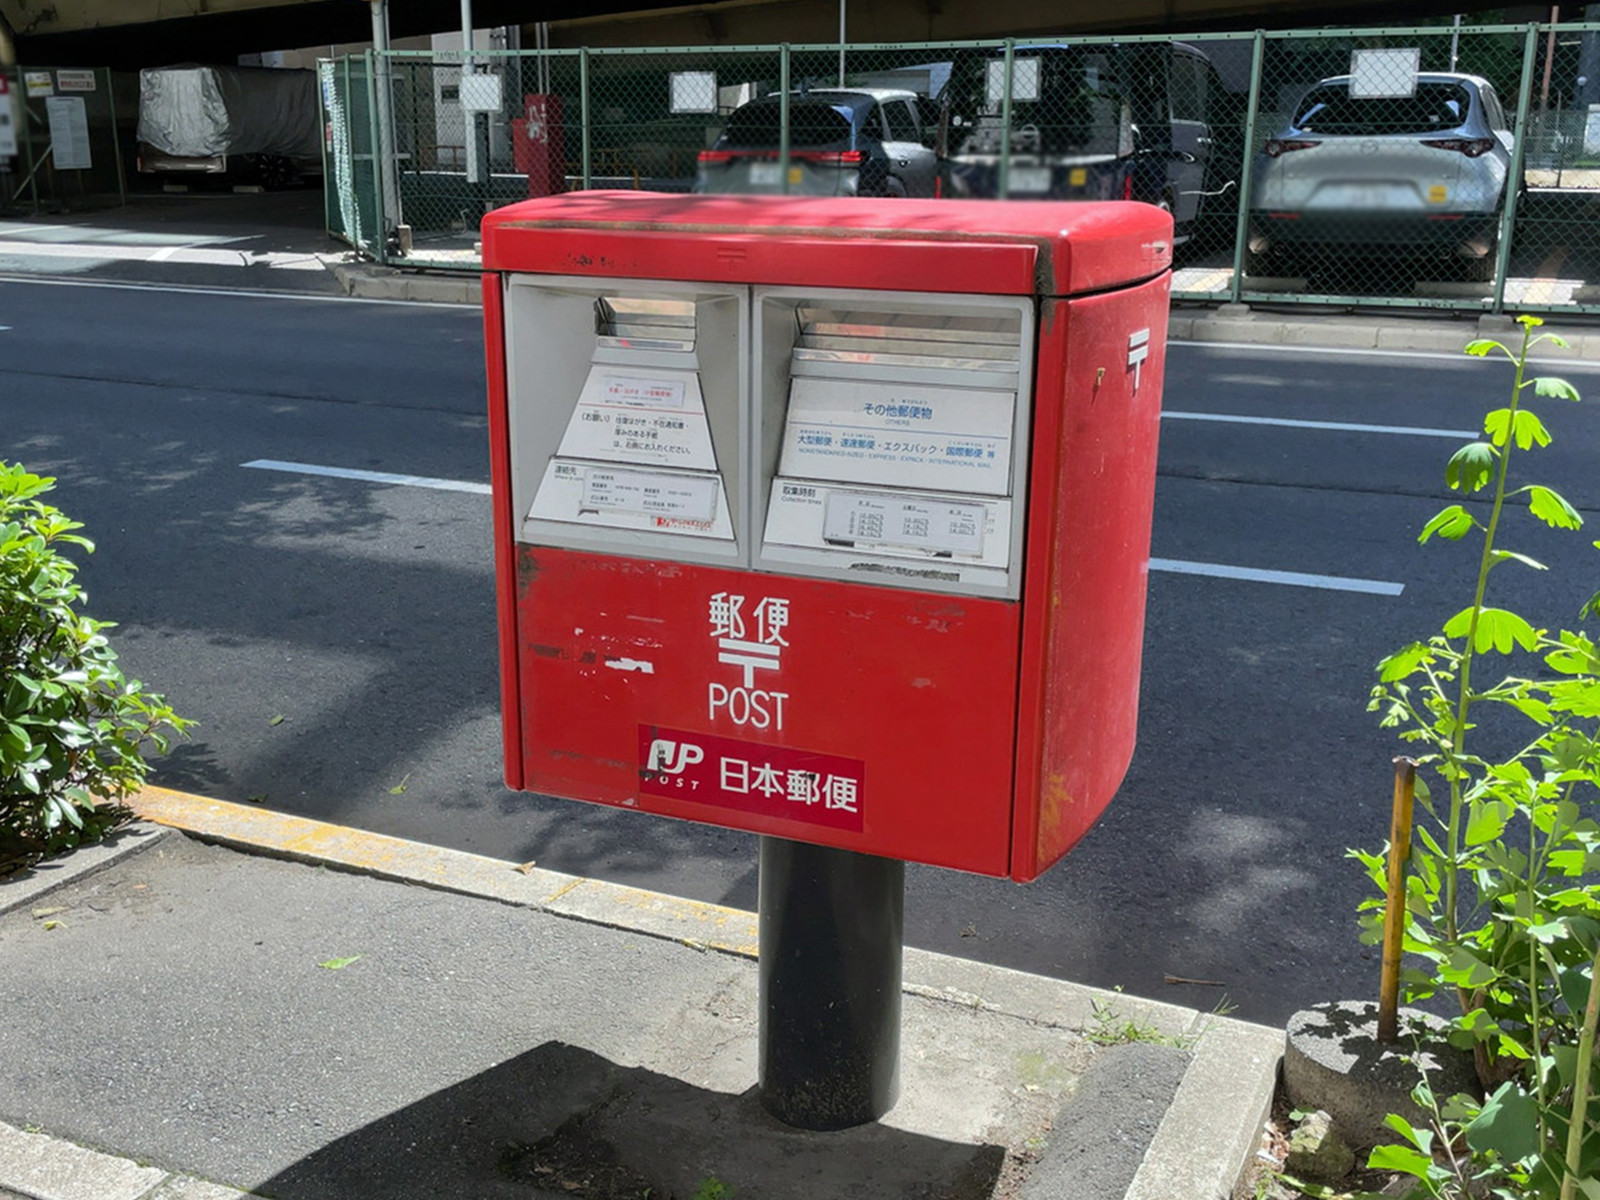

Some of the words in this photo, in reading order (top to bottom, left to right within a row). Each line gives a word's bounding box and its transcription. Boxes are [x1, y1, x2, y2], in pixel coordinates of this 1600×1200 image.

[863, 403, 933, 420] その他郵便物
[708, 591, 790, 647] 郵便
[708, 683, 789, 731] POST
[720, 756, 858, 813] 日本郵便
